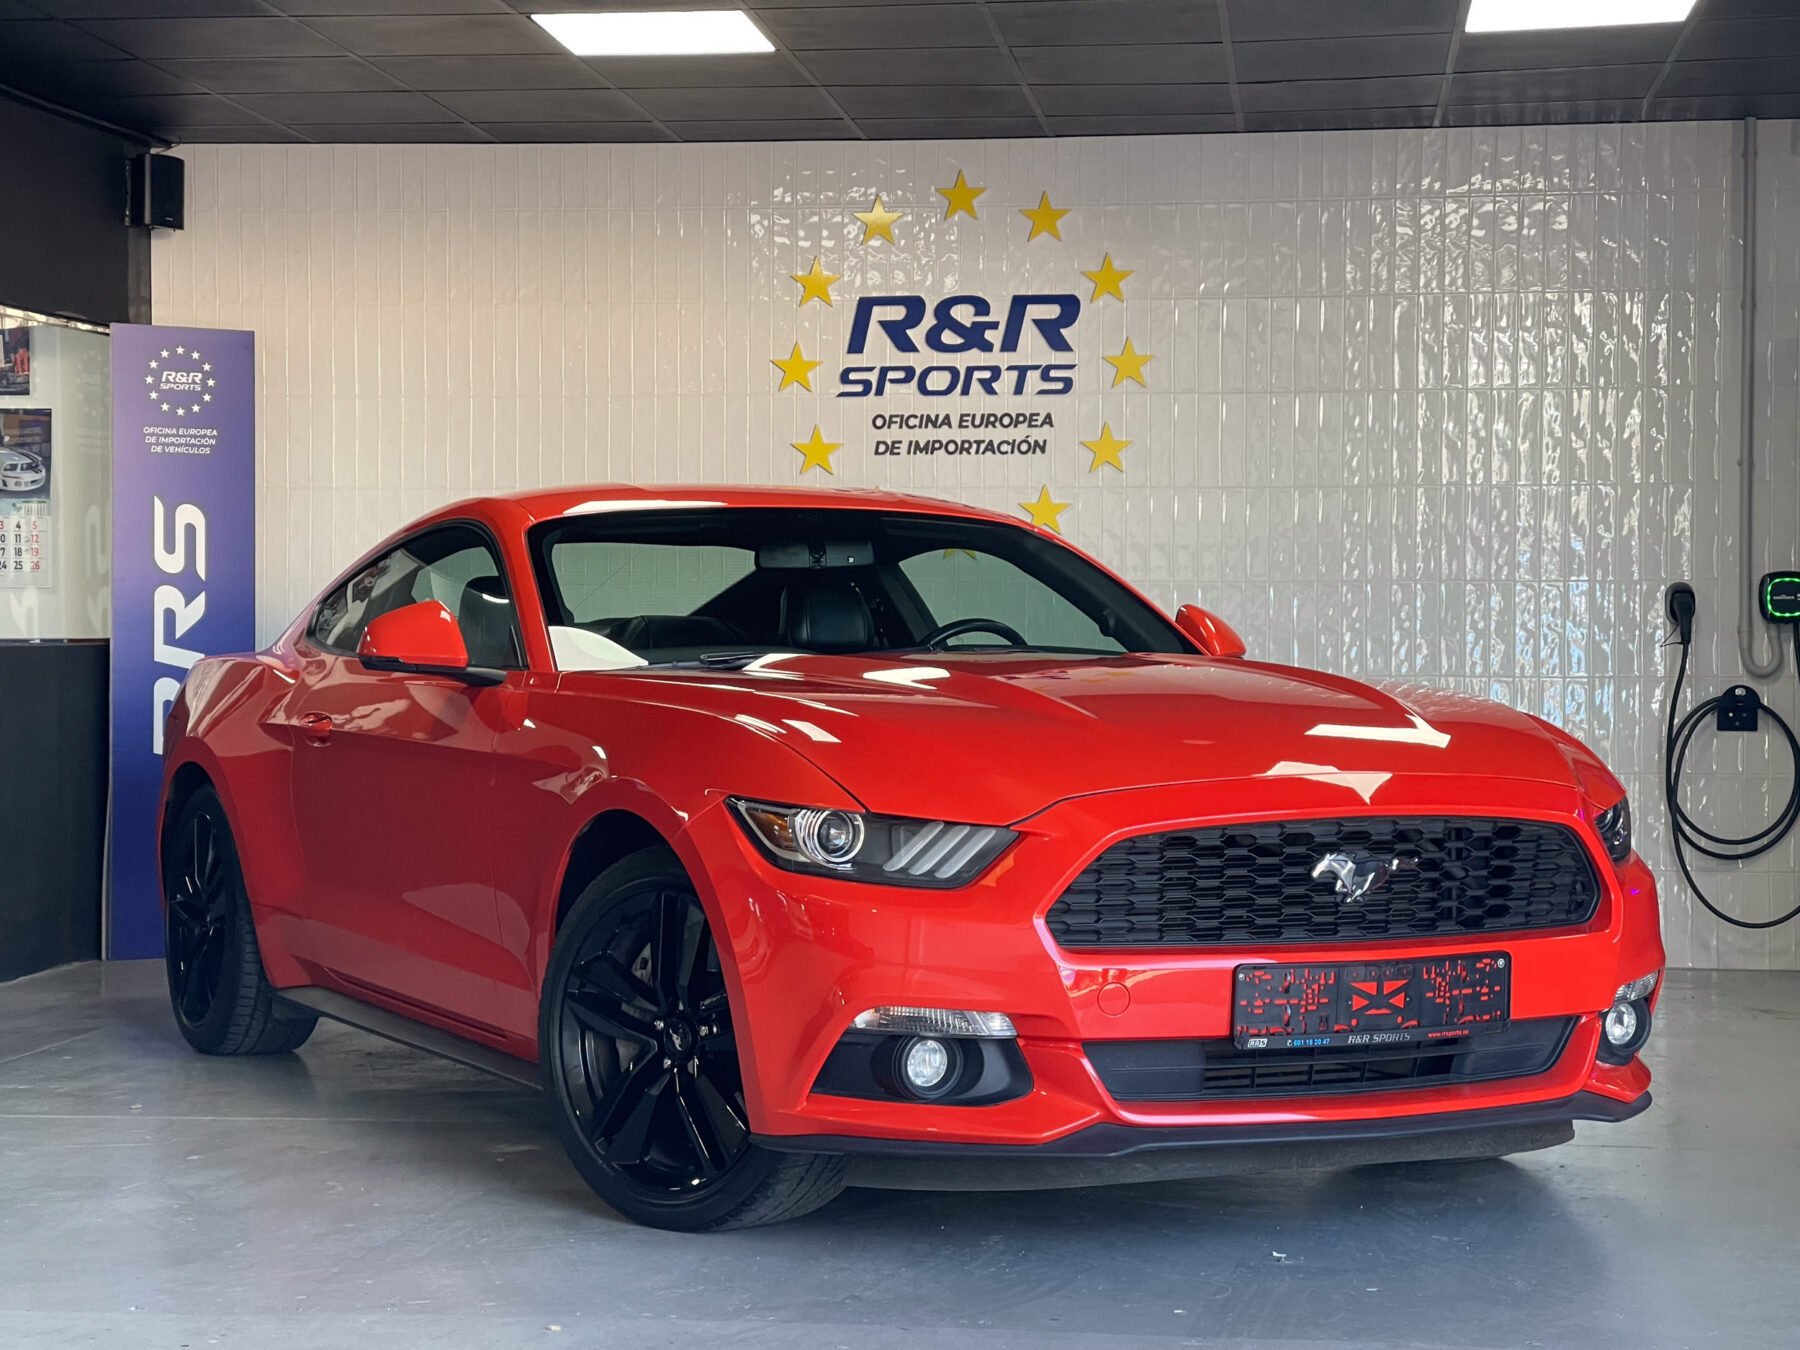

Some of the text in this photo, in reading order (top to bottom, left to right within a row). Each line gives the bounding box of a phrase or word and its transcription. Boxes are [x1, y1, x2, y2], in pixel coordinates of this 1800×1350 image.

[846, 294, 1081, 354] R&R
[161, 371, 202, 383] R&R
[836, 364, 1078, 398] SPORTS
[160, 382, 201, 391] SPORTS
[872, 412, 1054, 430] OFICINA EUROPEA
[143, 426, 218, 436] OFICINA EUROPEA
[158, 436, 216, 445] IMPORTACIÓN
[874, 435, 1047, 456] DE IMPORTACIÓN
[151, 445, 211, 454] DE VEHÍCULOS
[16, 520, 21, 530] 4
[14, 547, 22, 557] 18
[14, 561, 23, 570] 25
[1347, 1034, 1369, 1044] R&R
[1372, 1032, 1410, 1042] SPORTS
